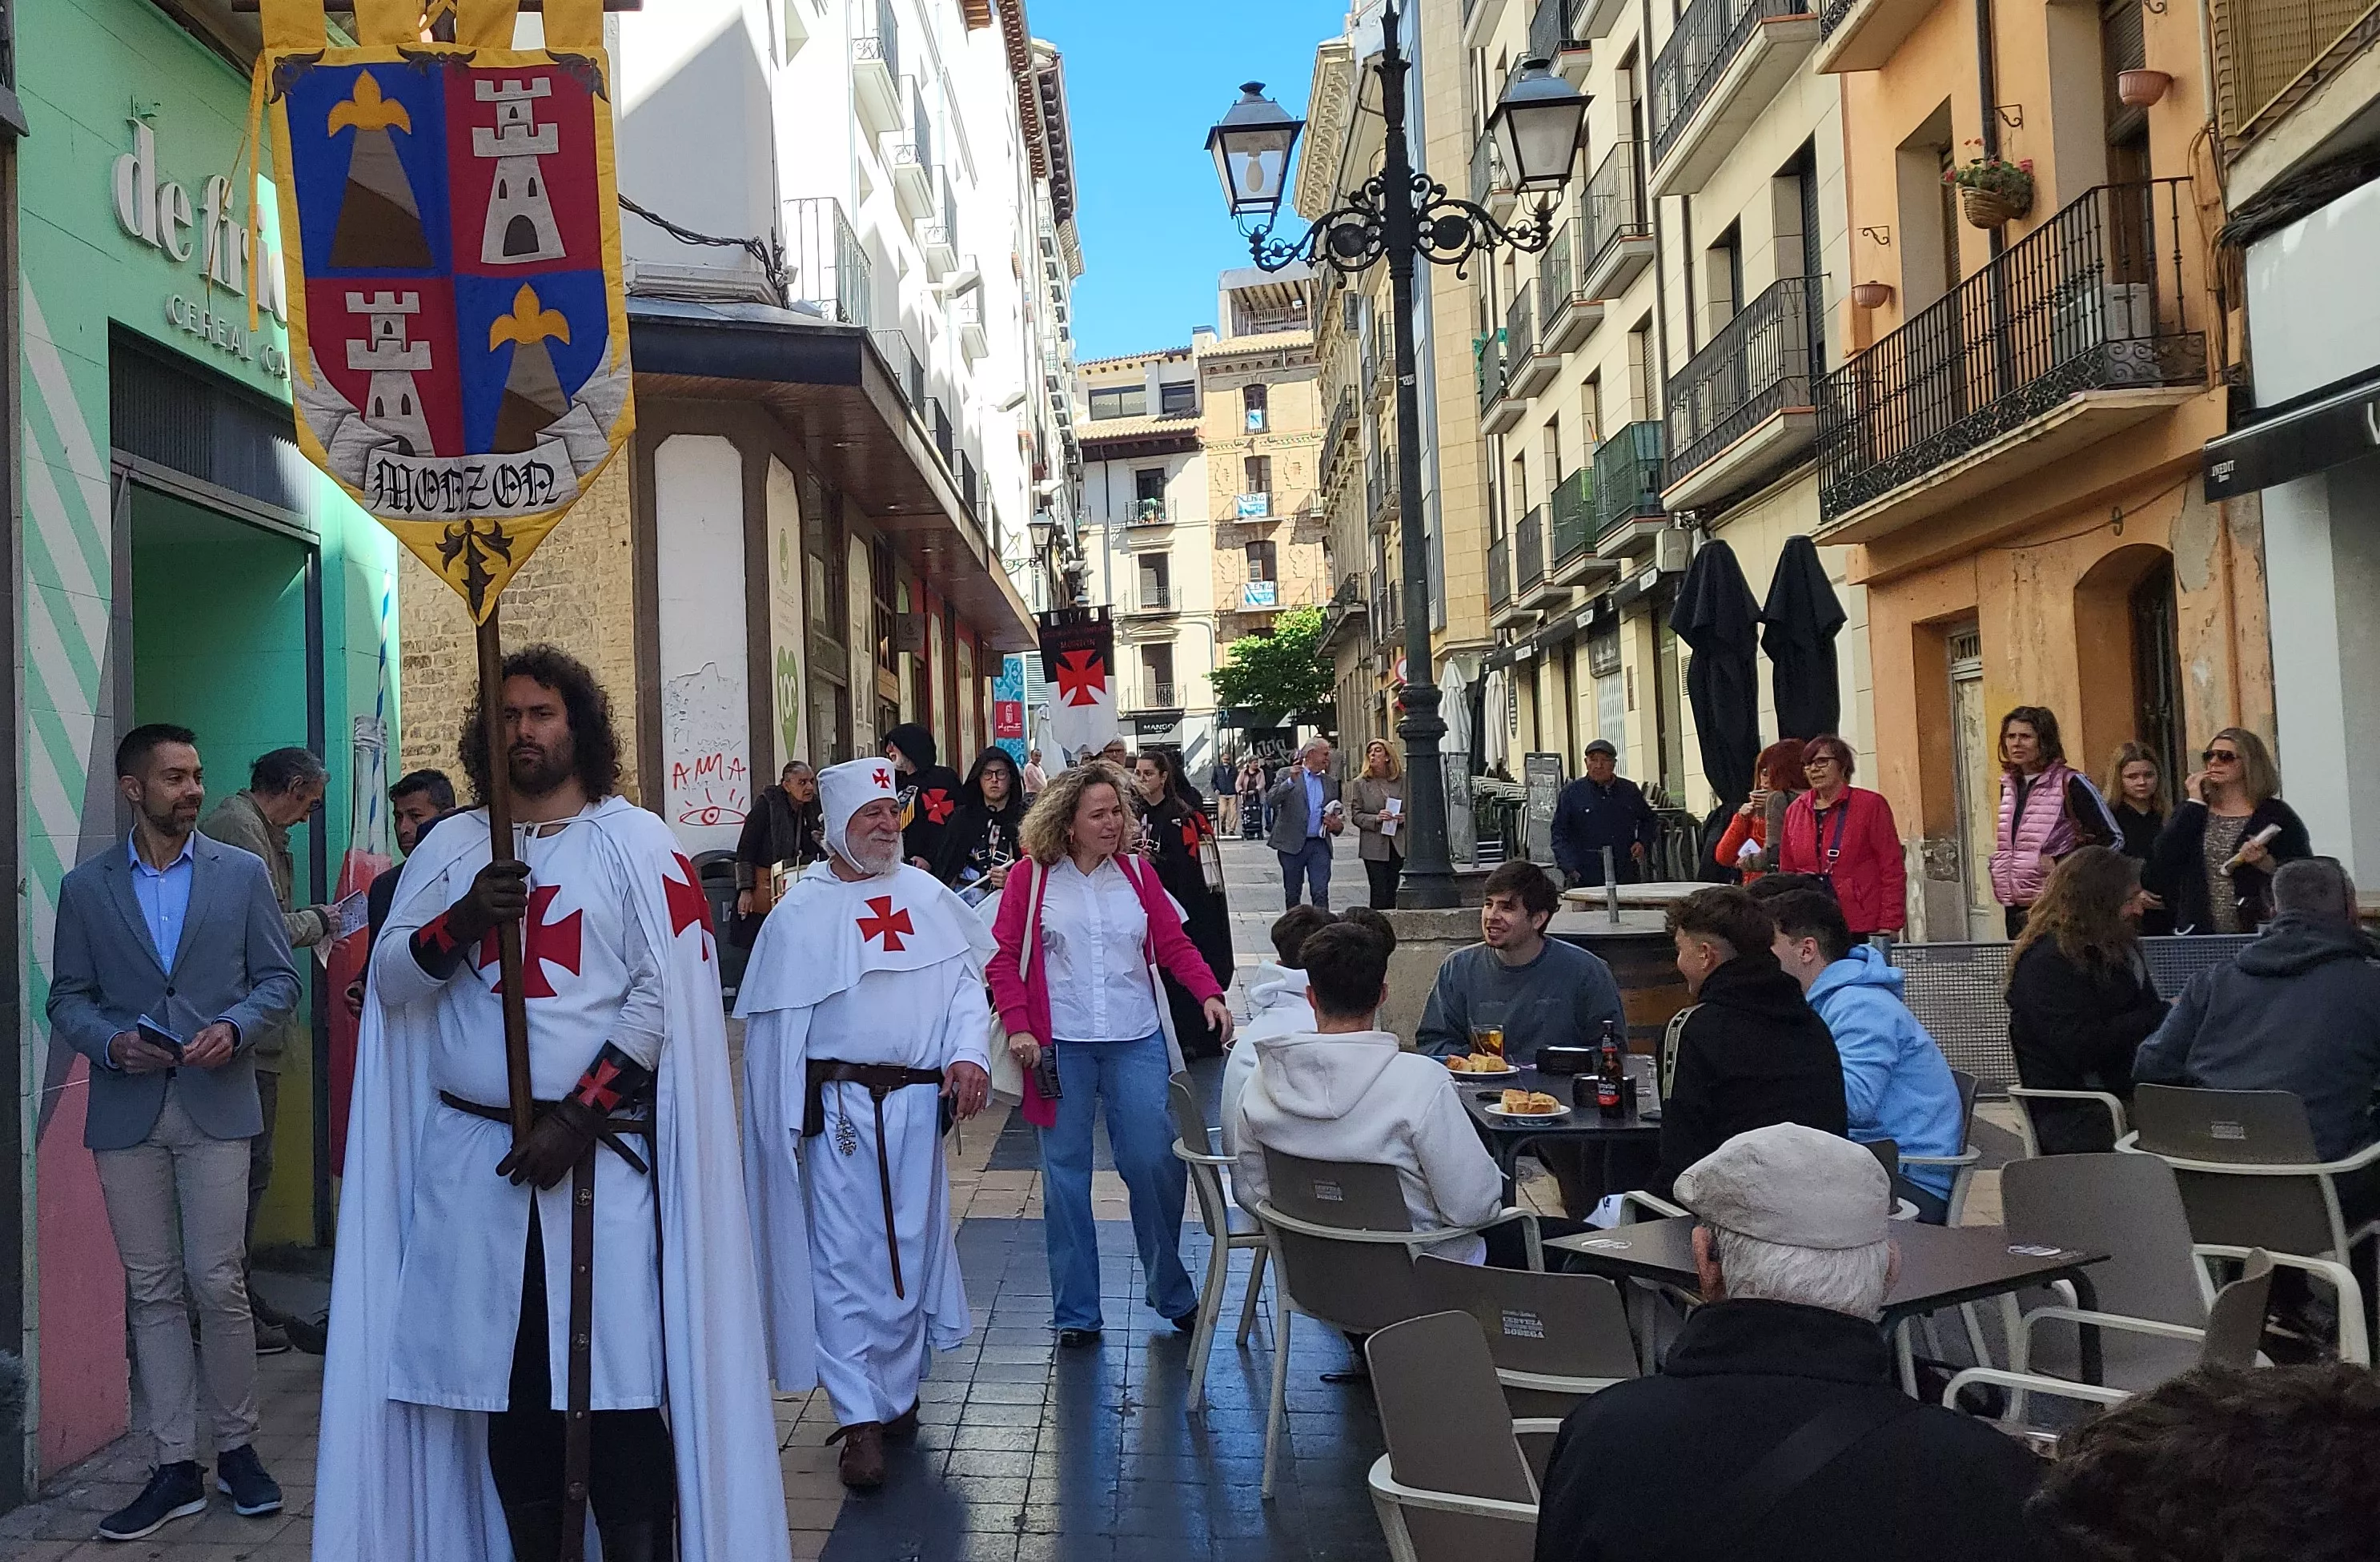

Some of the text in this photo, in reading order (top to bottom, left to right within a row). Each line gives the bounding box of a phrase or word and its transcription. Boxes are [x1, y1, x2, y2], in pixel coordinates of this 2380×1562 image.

[111, 117, 193, 263] de
[166, 293, 253, 362] CEREAL
[672, 753, 747, 791] AMA
